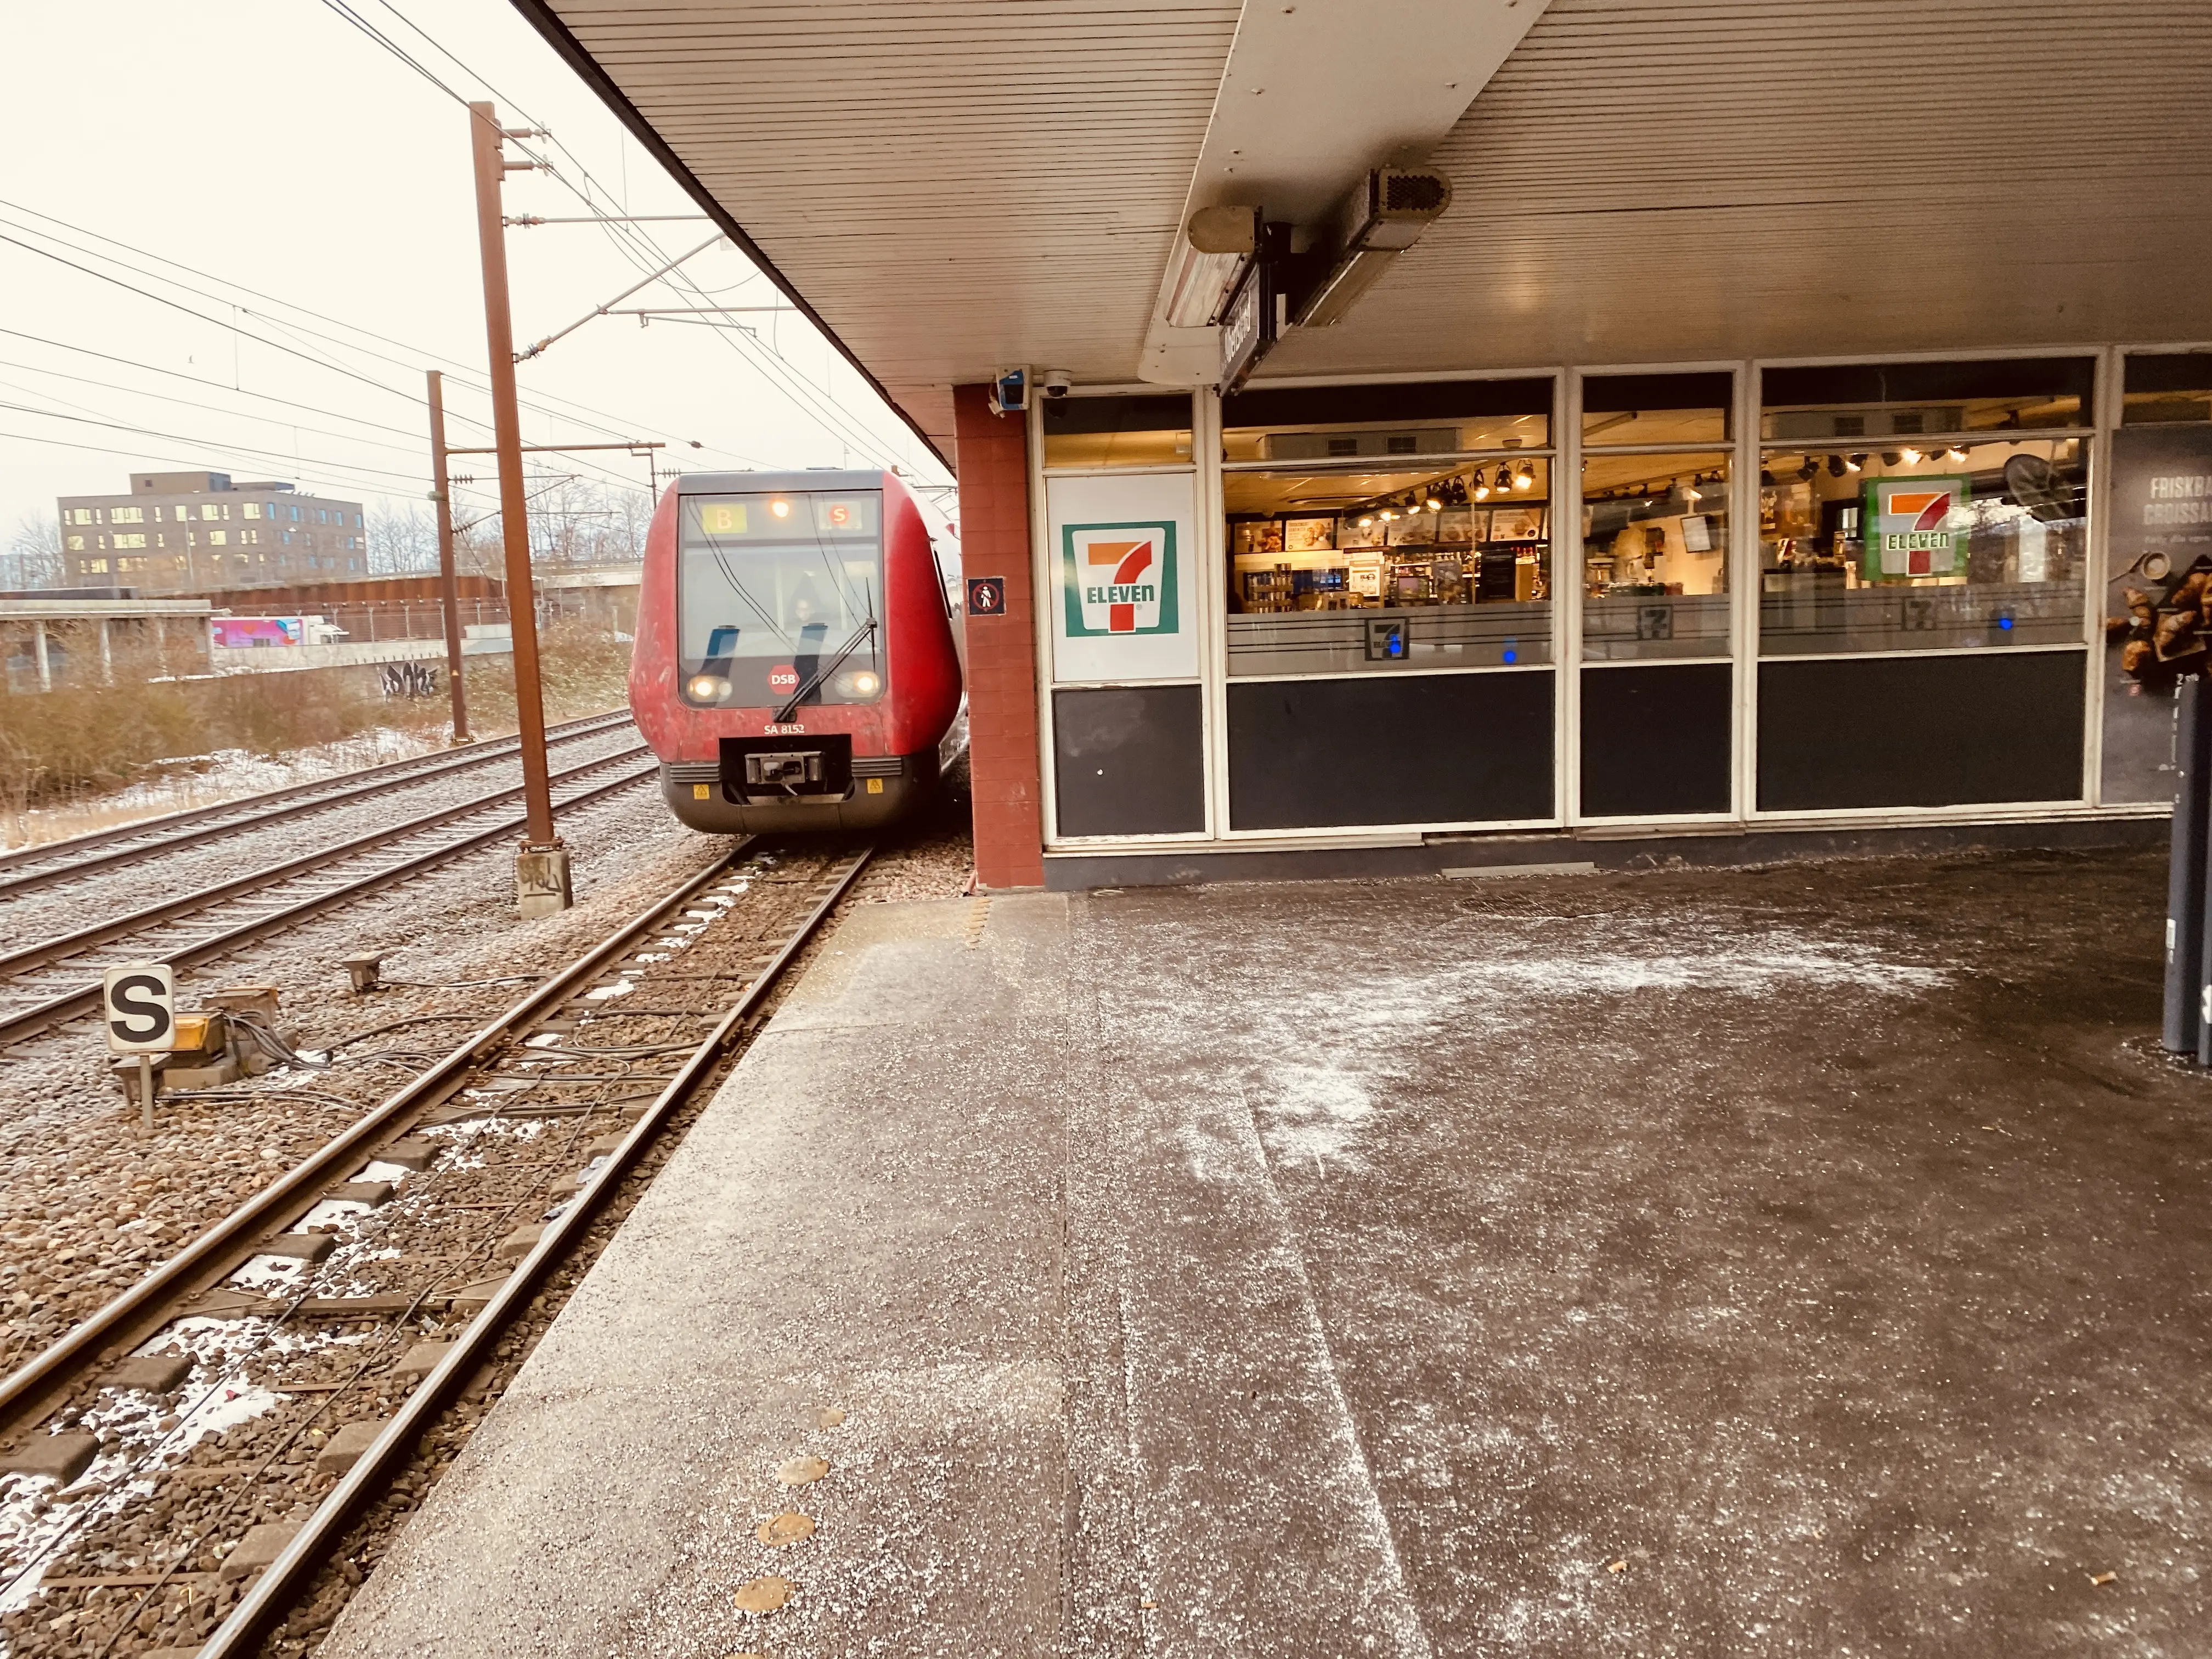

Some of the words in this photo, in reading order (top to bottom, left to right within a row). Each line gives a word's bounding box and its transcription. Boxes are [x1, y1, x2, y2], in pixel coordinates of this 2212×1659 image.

[716, 509, 732, 529] B
[833, 508, 845, 521] S
[1889, 491, 1950, 576] 7
[1088, 540, 1152, 631] 7
[1645, 610, 1666, 638] 7
[1374, 624, 1400, 658] 7
[771, 674, 796, 685] DSB
[764, 725, 778, 735] SA
[781, 724, 805, 734] 8152
[110, 975, 170, 1043] S
